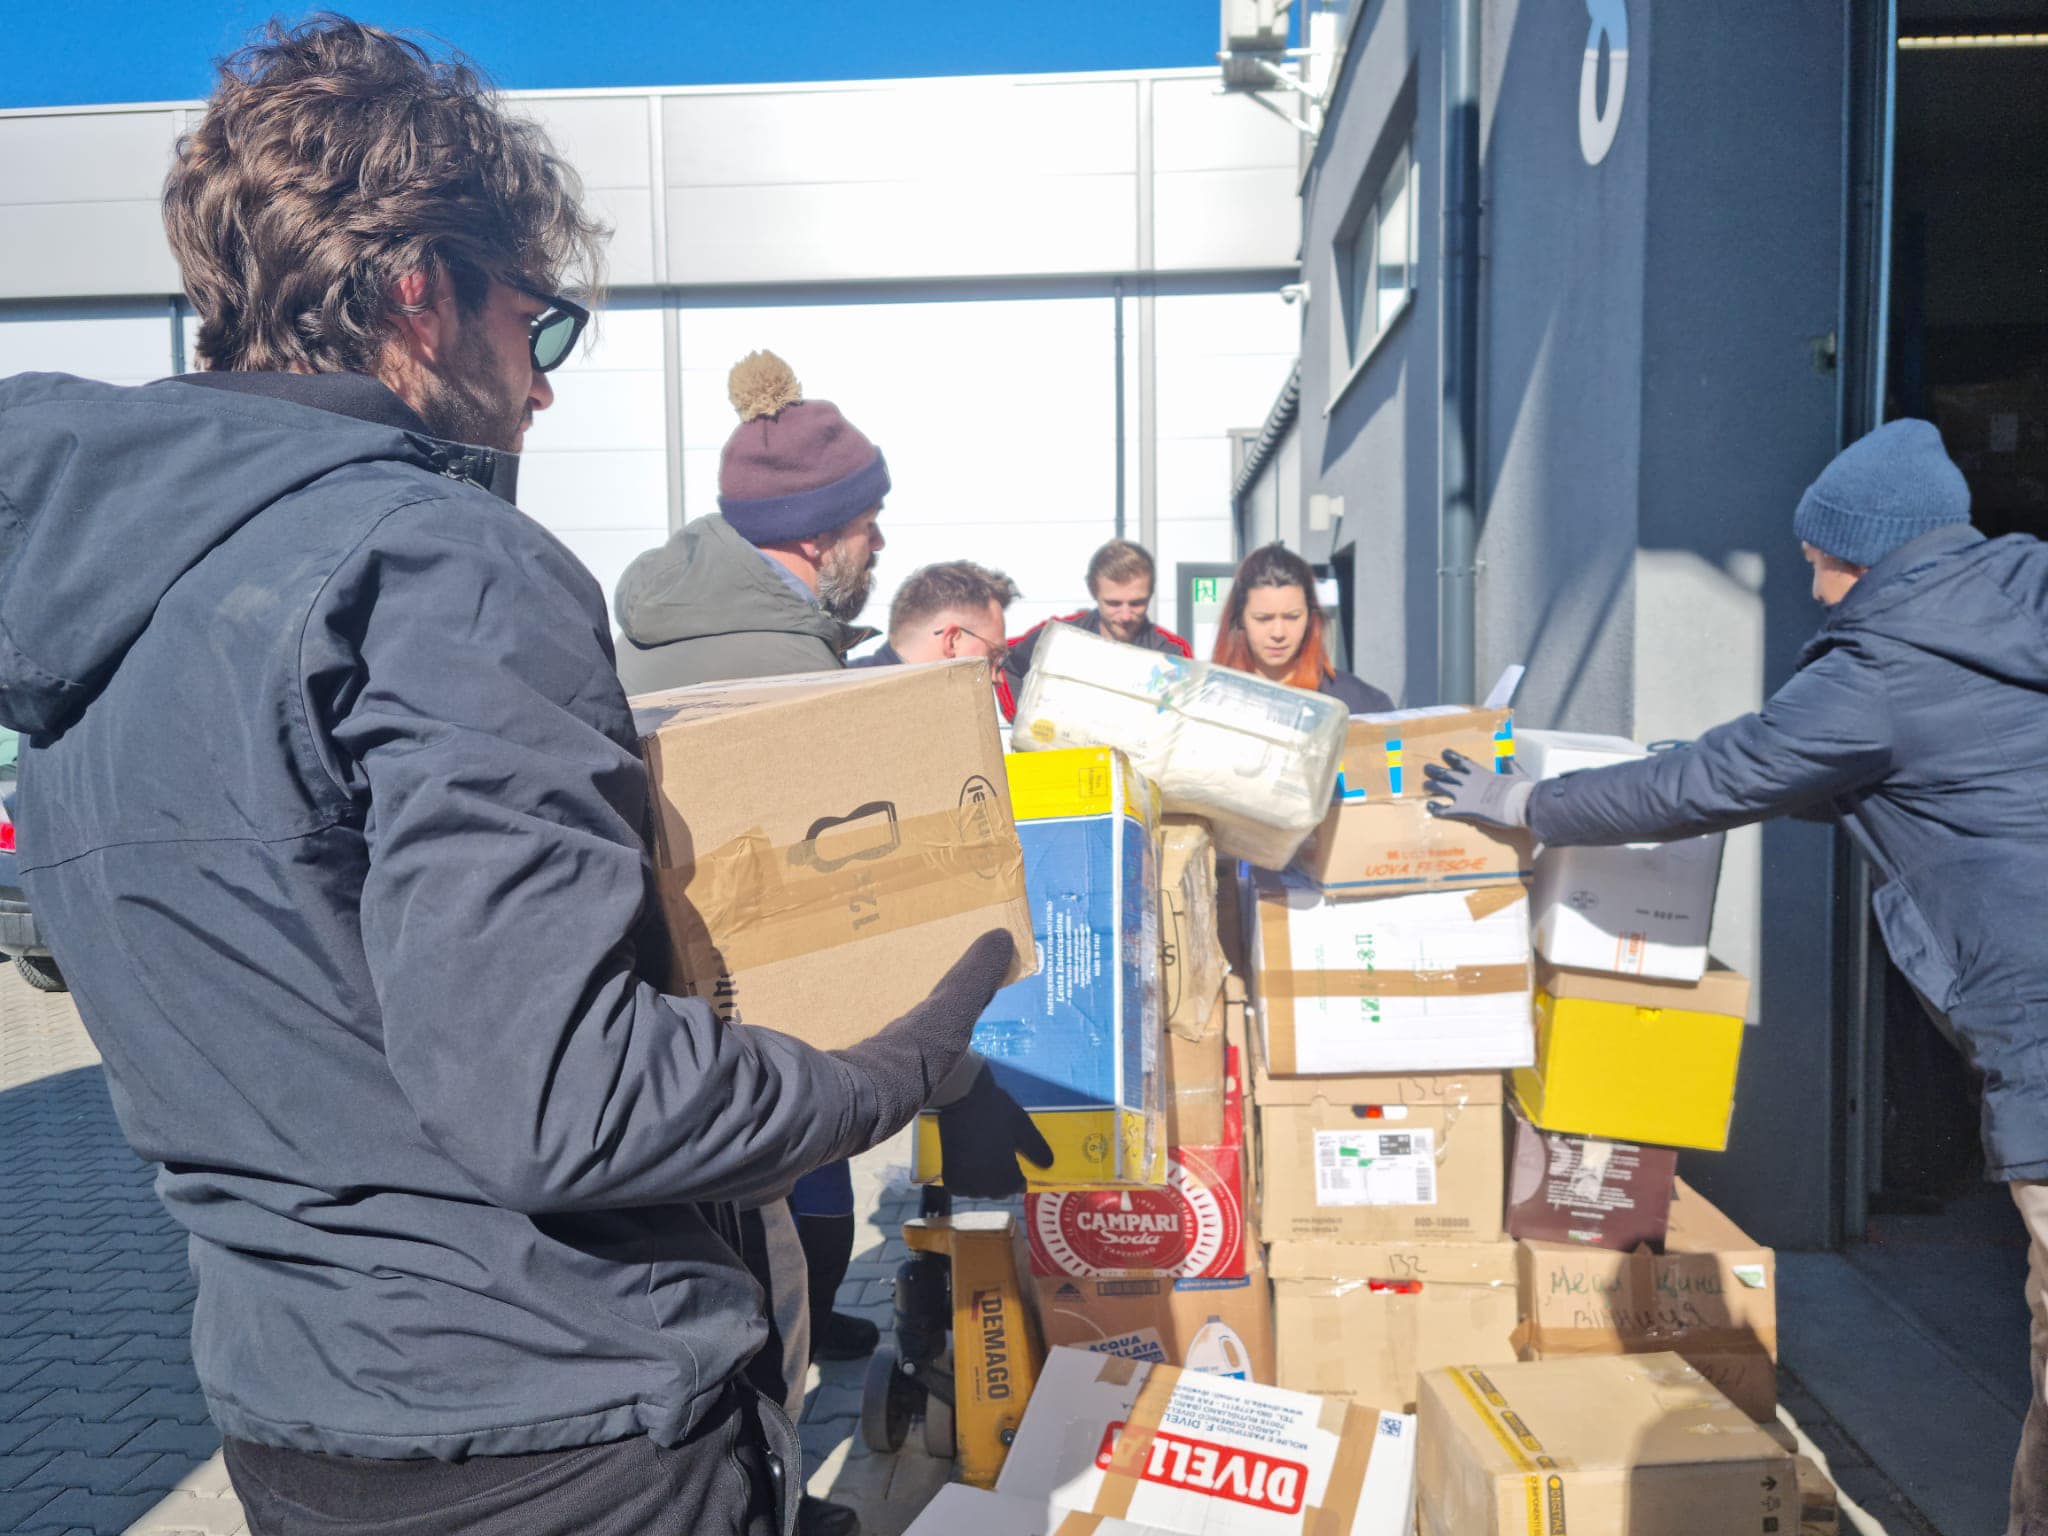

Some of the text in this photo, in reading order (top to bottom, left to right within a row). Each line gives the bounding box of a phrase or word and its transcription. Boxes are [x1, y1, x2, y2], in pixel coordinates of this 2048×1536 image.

[1365, 861, 1409, 878] UOVA
[1055, 912, 1065, 1002] Lenta Essiccazione
[1077, 1211, 1180, 1232] CAMPARI
[1096, 1228, 1162, 1245] Soda
[982, 1296, 1010, 1400] DEMAGO
[1089, 1335, 1141, 1353] ACQUA
[1166, 1412, 1202, 1429] DIVEL
